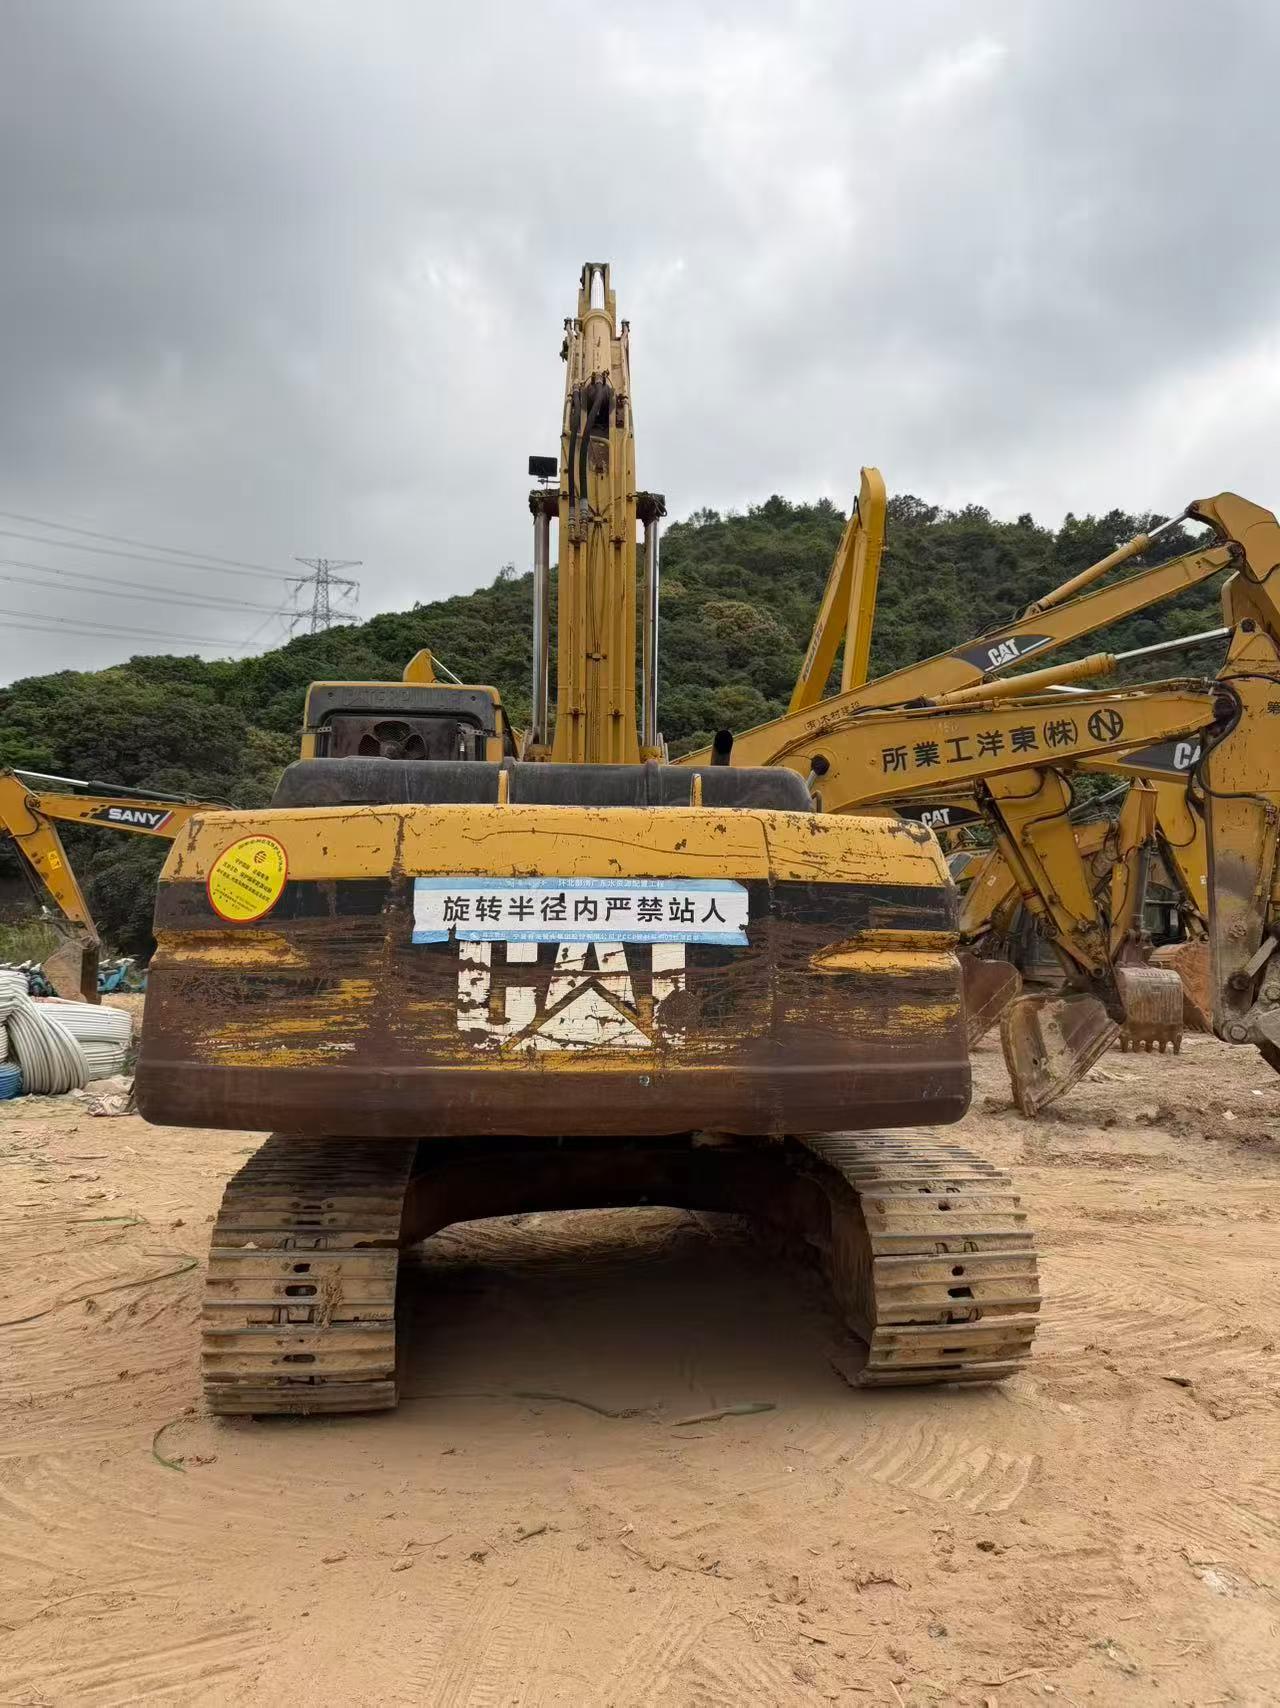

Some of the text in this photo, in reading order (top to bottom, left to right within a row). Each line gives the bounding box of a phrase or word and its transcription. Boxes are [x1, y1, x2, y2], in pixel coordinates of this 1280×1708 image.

[988, 637, 1020, 666] CAT
[108, 808, 160, 825] SANY
[921, 808, 950, 828] CAT
[442, 894, 727, 924] 旋转半径内严禁站人
